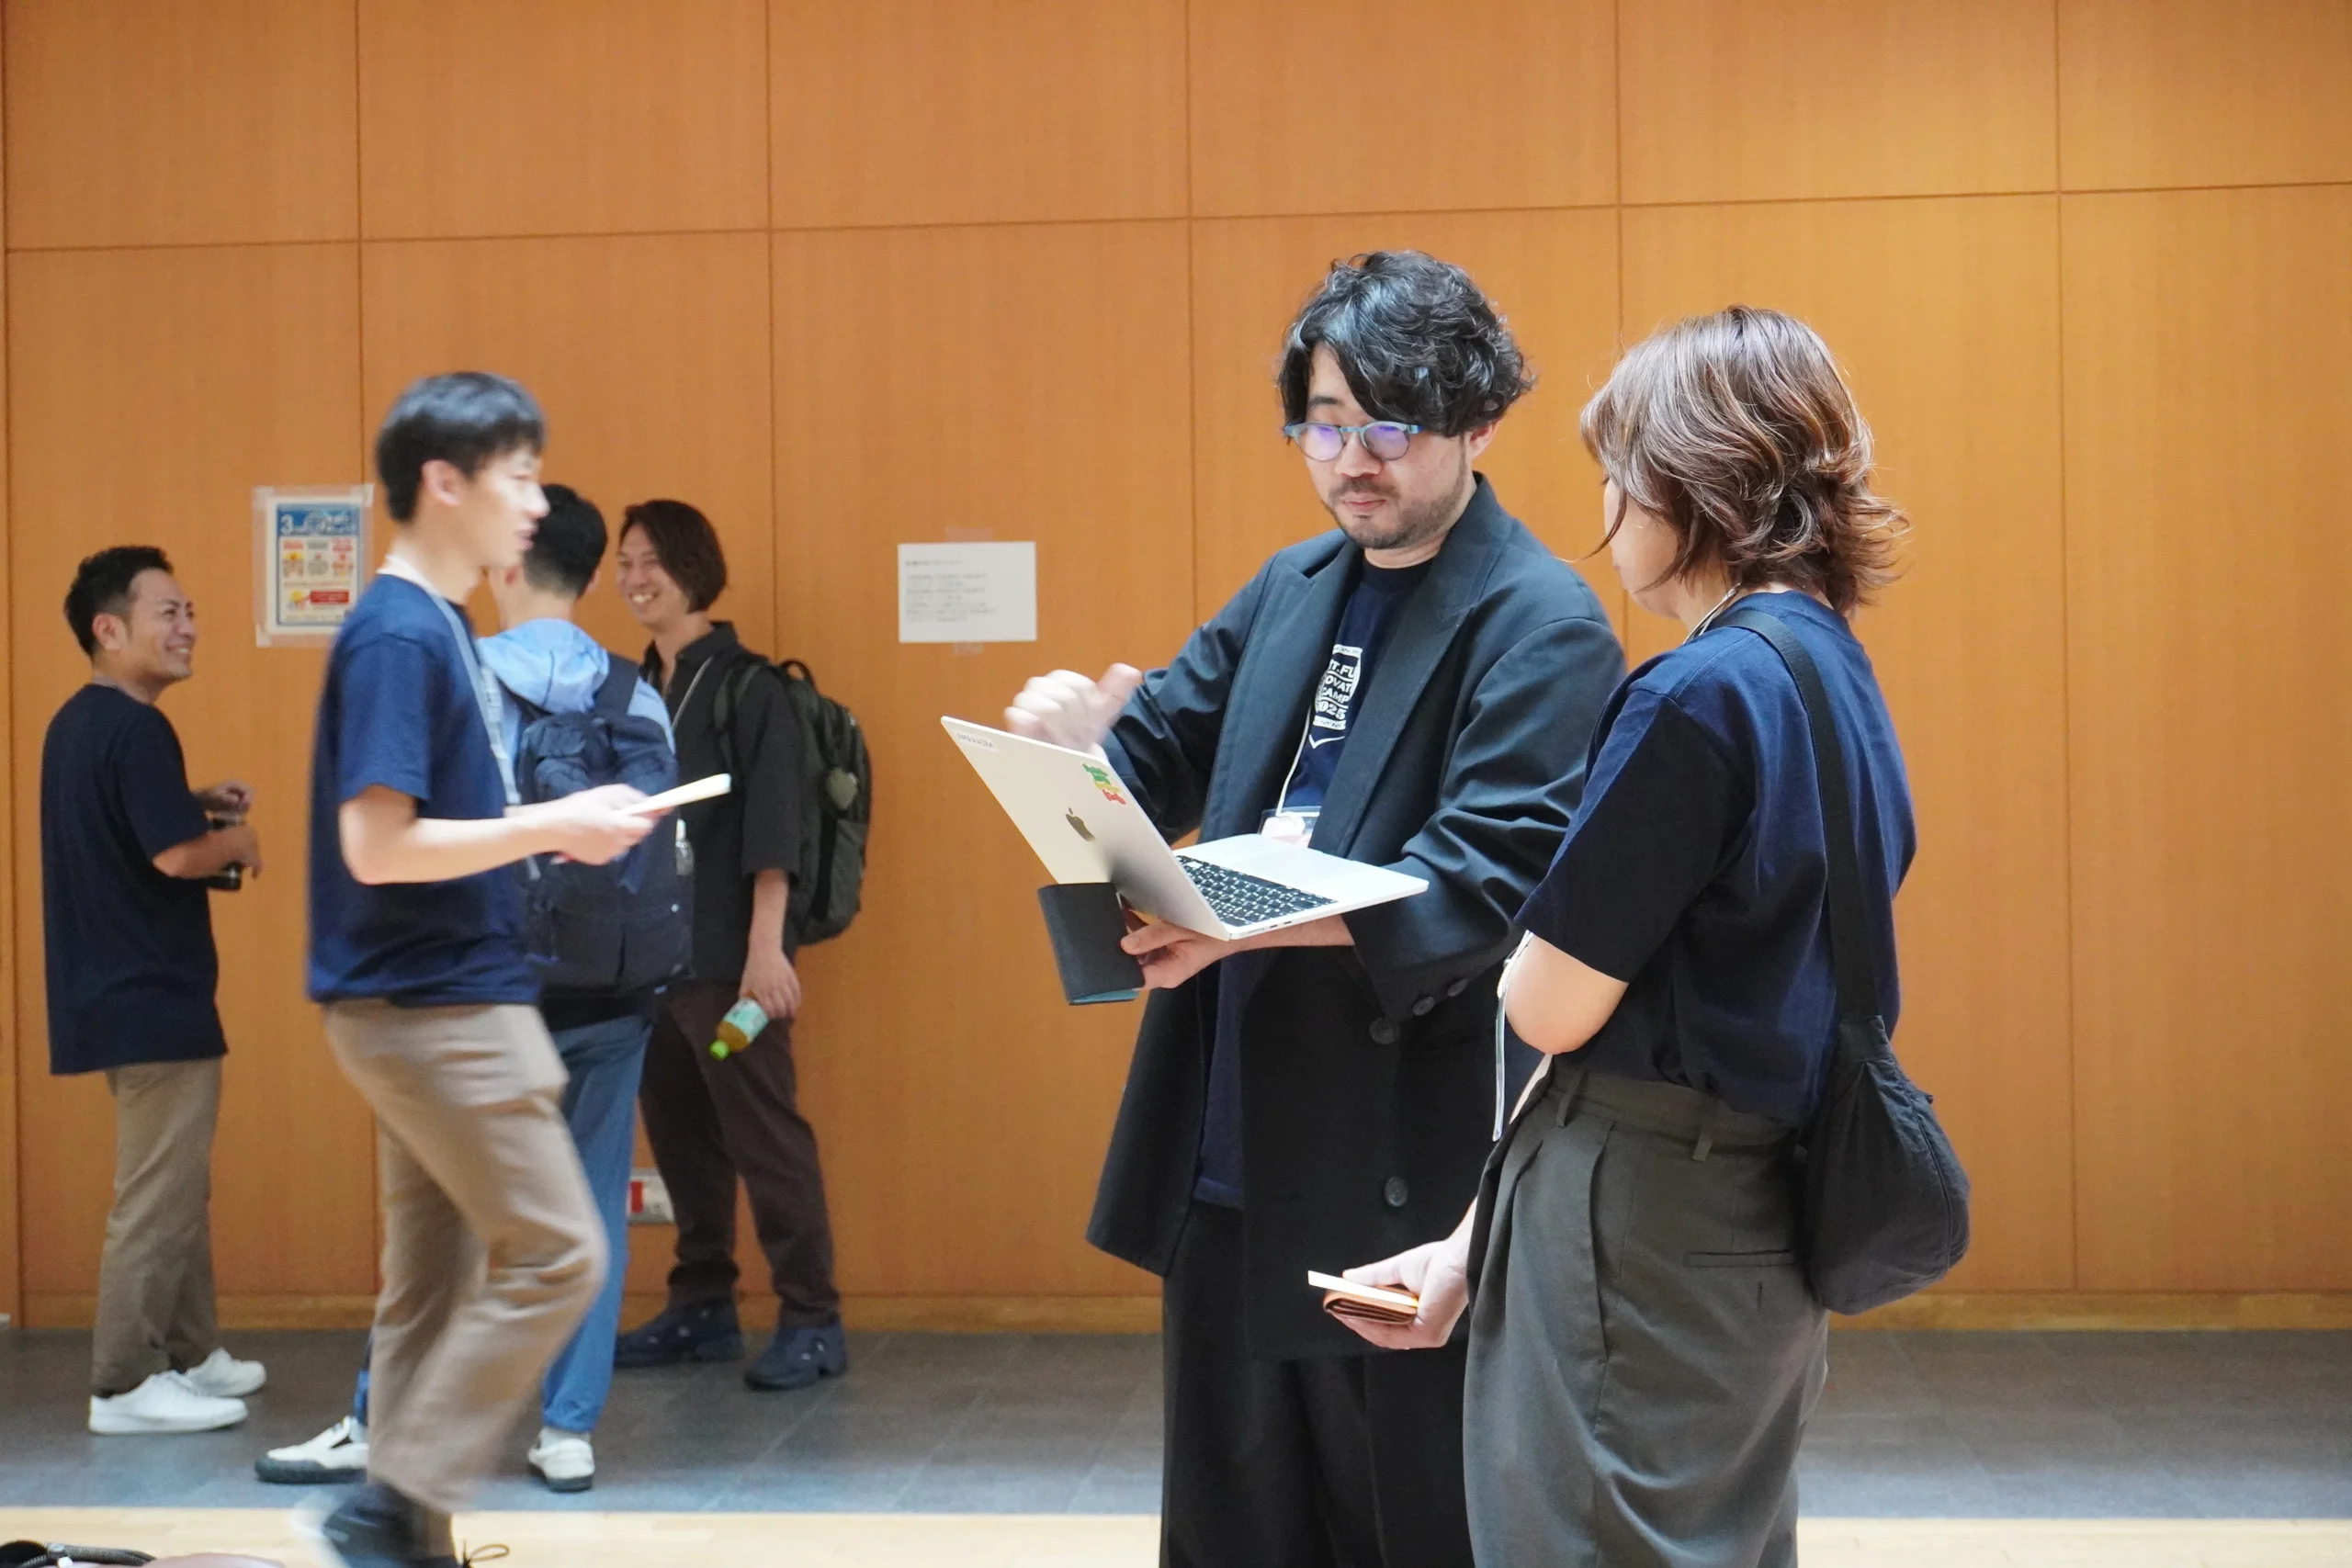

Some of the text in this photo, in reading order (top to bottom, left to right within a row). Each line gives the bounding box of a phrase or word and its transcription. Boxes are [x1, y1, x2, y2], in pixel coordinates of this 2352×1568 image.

[1329, 659, 1355, 678] T.FU
[1325, 674, 1351, 693] OVAT
[1318, 700, 1347, 720] 025
